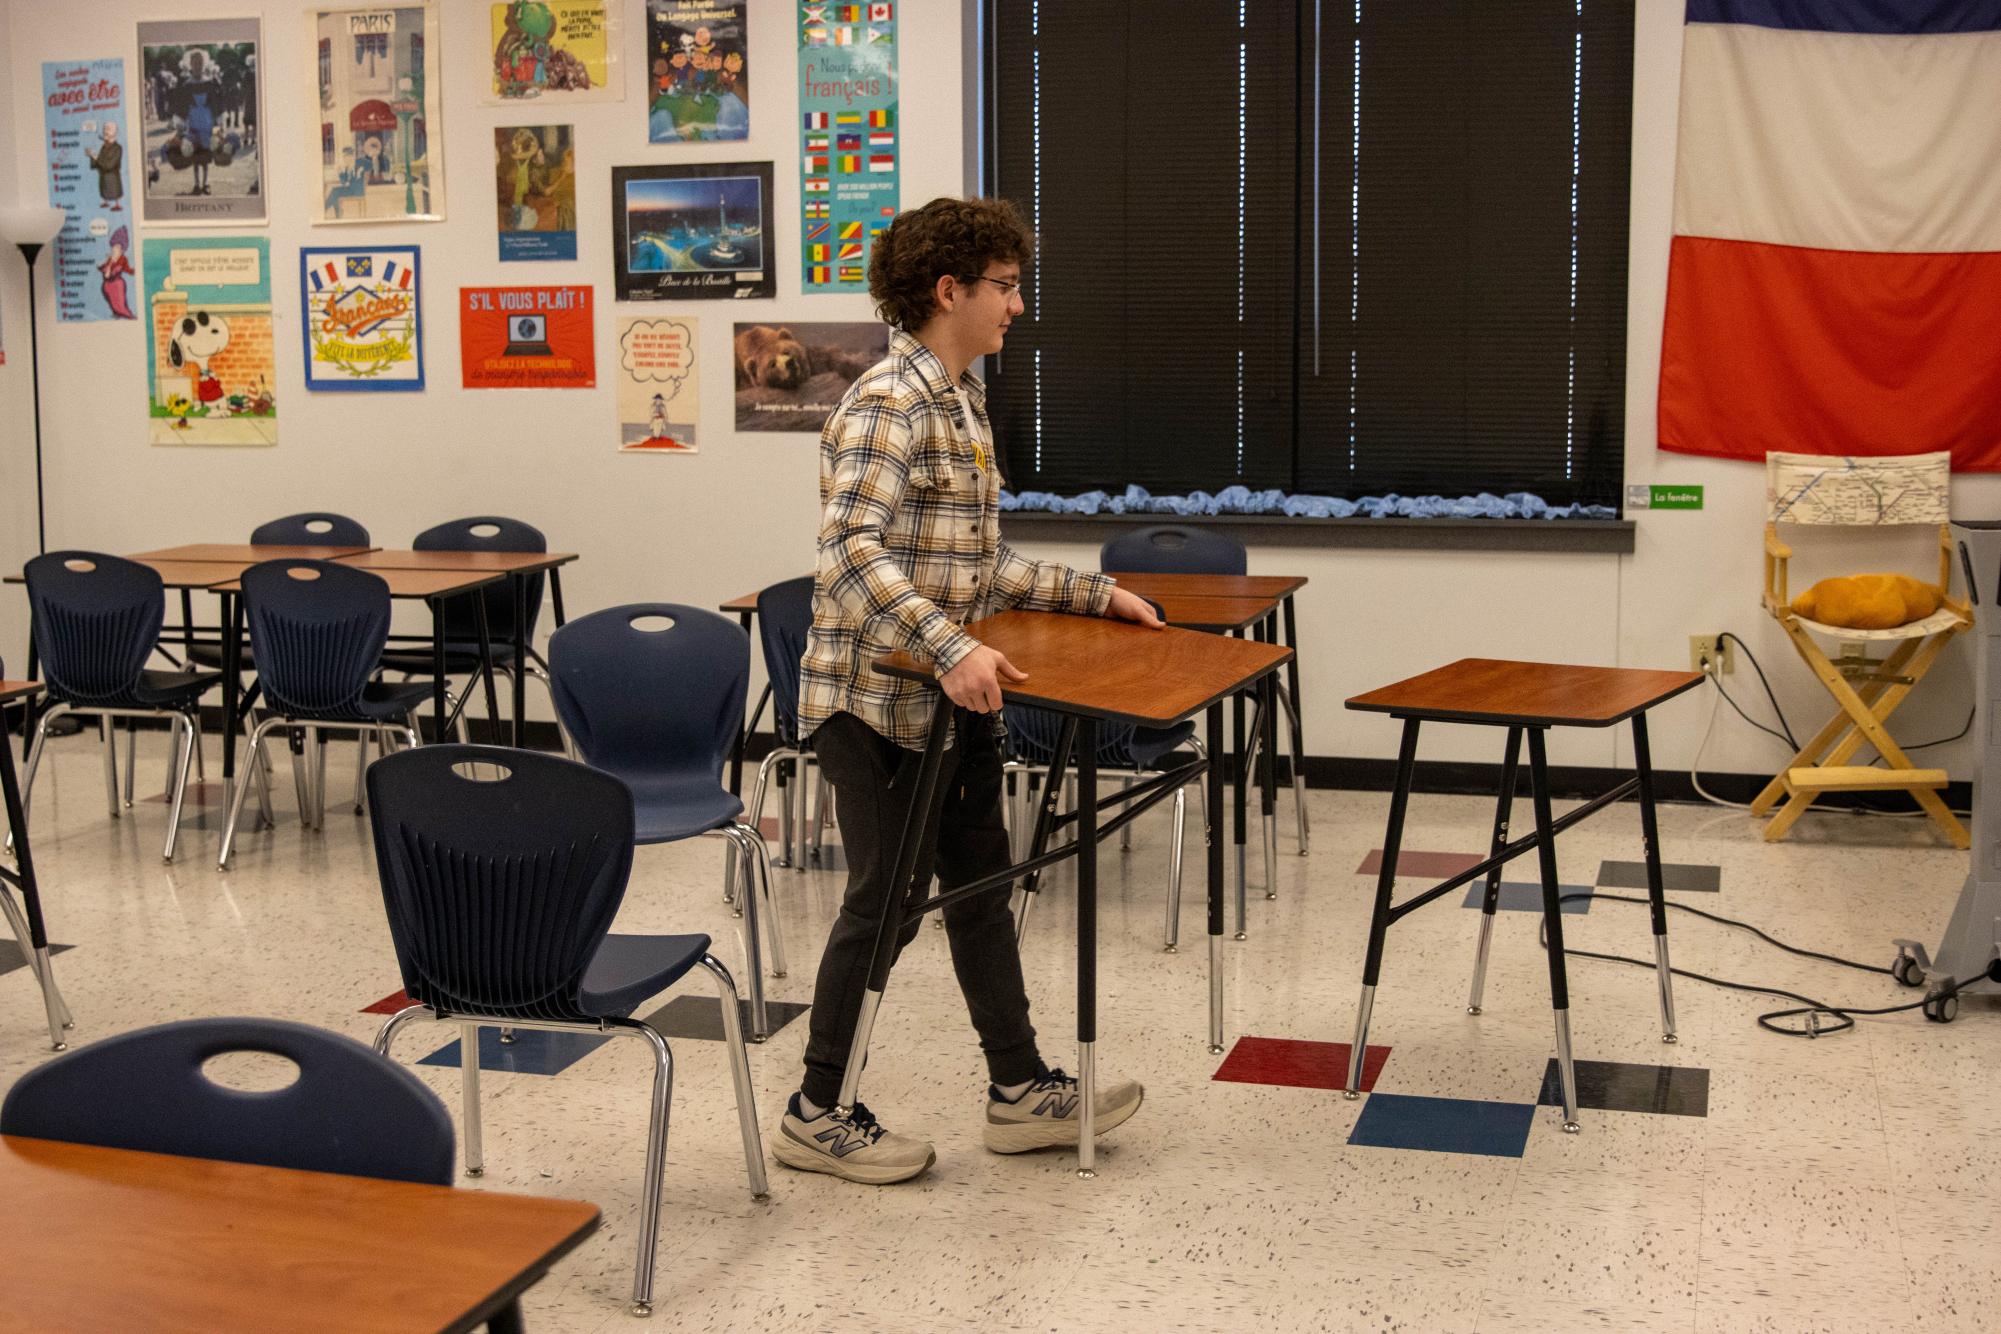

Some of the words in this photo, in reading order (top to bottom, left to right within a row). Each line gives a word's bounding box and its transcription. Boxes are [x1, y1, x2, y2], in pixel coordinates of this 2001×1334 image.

[351, 14, 392, 33] PARIS
[668, 12, 700, 22] Langage
[821, 57, 846, 73] Nous
[48, 89, 84, 107] avec
[88, 79, 120, 101] être
[806, 64, 880, 106] français
[887, 61, 892, 96] !
[658, 274, 681, 287] Place
[682, 277, 691, 286] de
[692, 276, 700, 286] la
[702, 274, 731, 286] Bastille
[470, 293, 495, 311] S'IL
[499, 291, 534, 310] VOUS
[537, 287, 576, 310] PLAÎT
[579, 291, 585, 309] !
[1655, 492, 1666, 502] La
[1667, 491, 1698, 502] fenêtre
[1031, 1092, 1079, 1118] N
[814, 1125, 869, 1158] N
